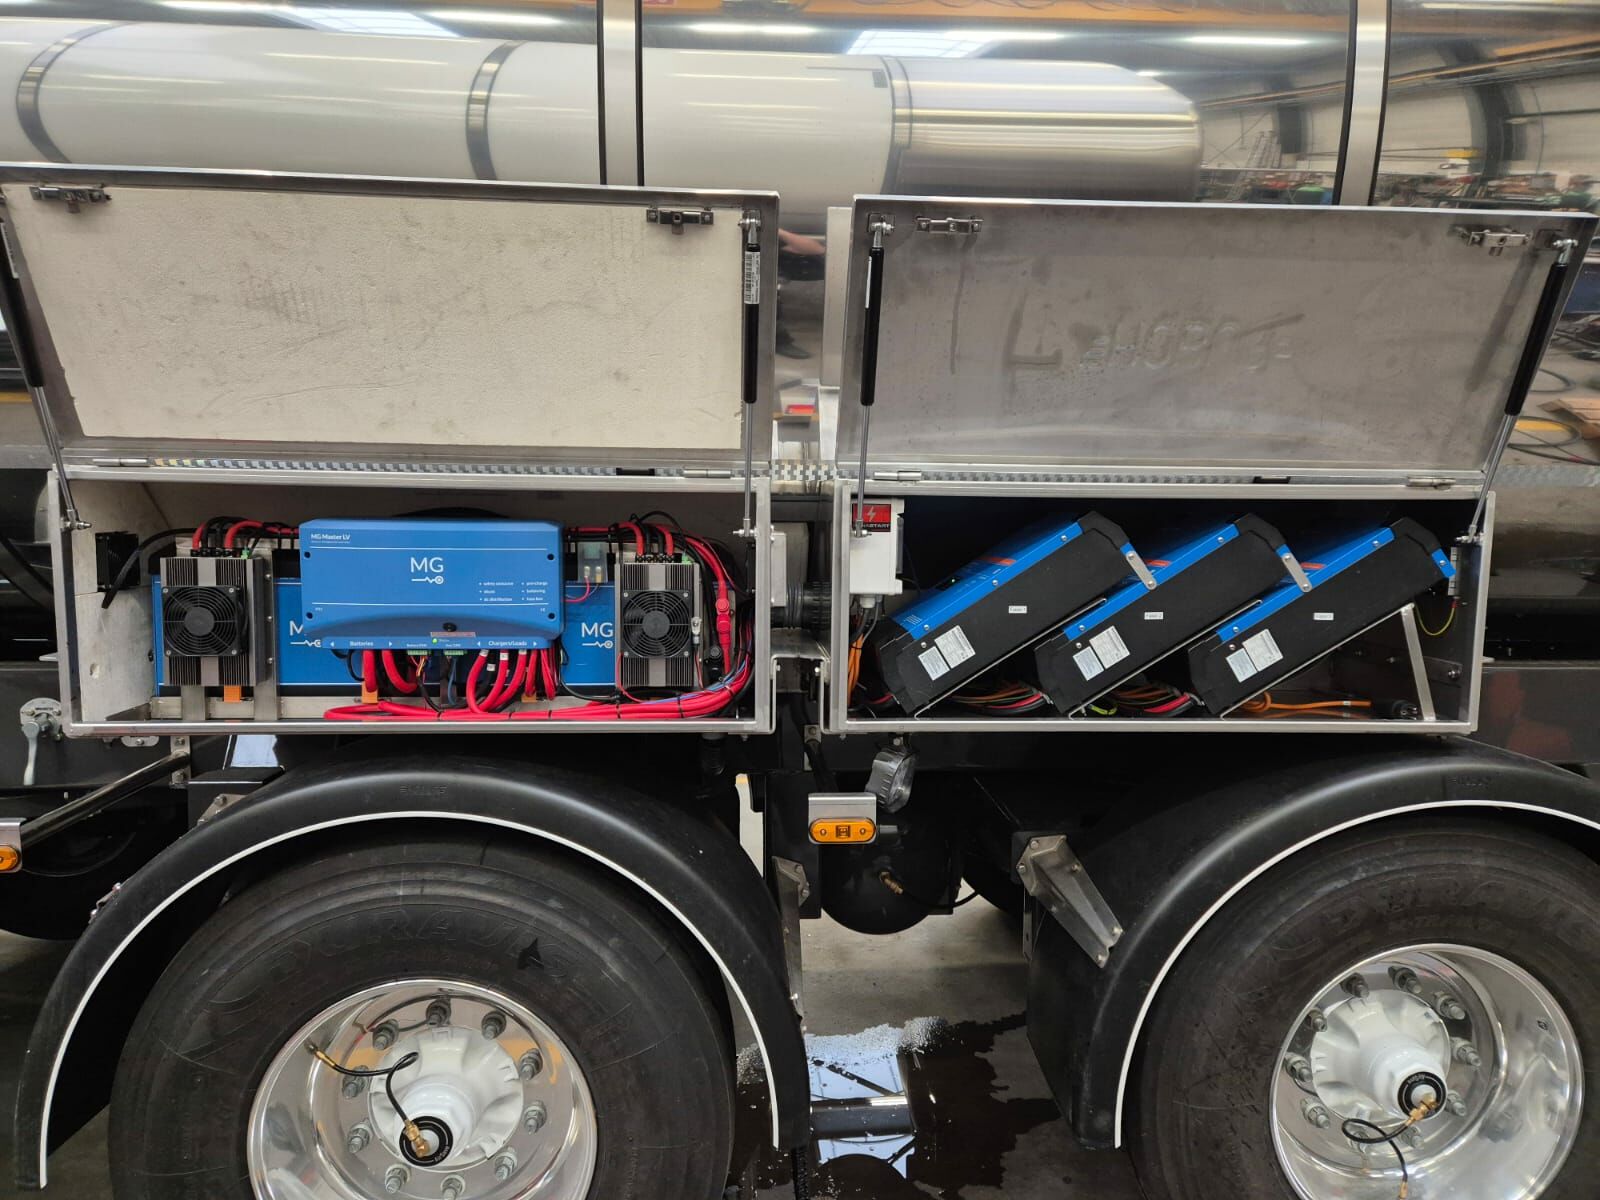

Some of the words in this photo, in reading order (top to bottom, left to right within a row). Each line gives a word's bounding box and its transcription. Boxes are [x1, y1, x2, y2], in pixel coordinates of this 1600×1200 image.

[410, 557, 444, 573] MG
[289, 620, 304, 636] M
[581, 622, 613, 638] MG
